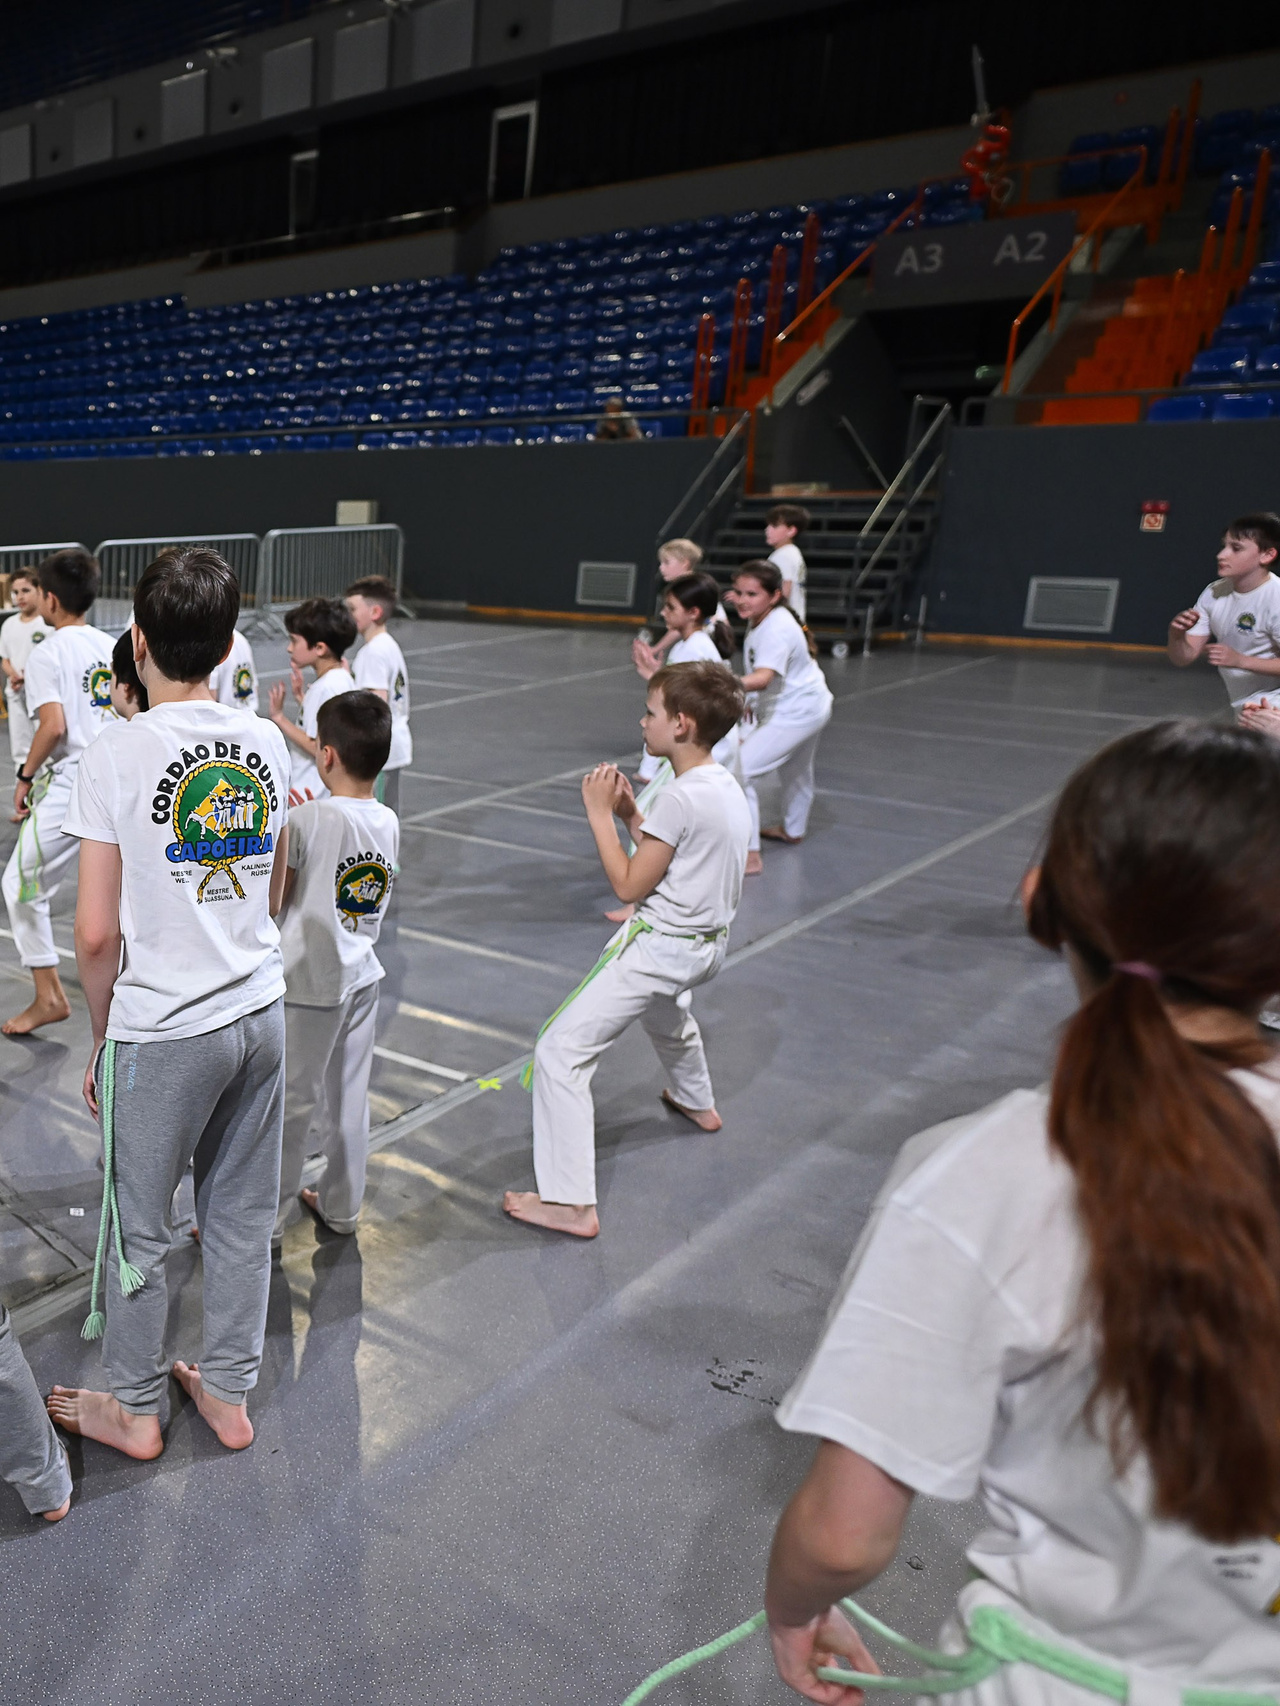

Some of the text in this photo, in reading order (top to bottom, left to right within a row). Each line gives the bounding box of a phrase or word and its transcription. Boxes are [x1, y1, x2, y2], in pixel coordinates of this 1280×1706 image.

[894, 231, 1047, 276] A3 A2
[151, 741, 278, 824] CORDÃO DE OURO
[165, 832, 274, 864] CAPOEIRA
